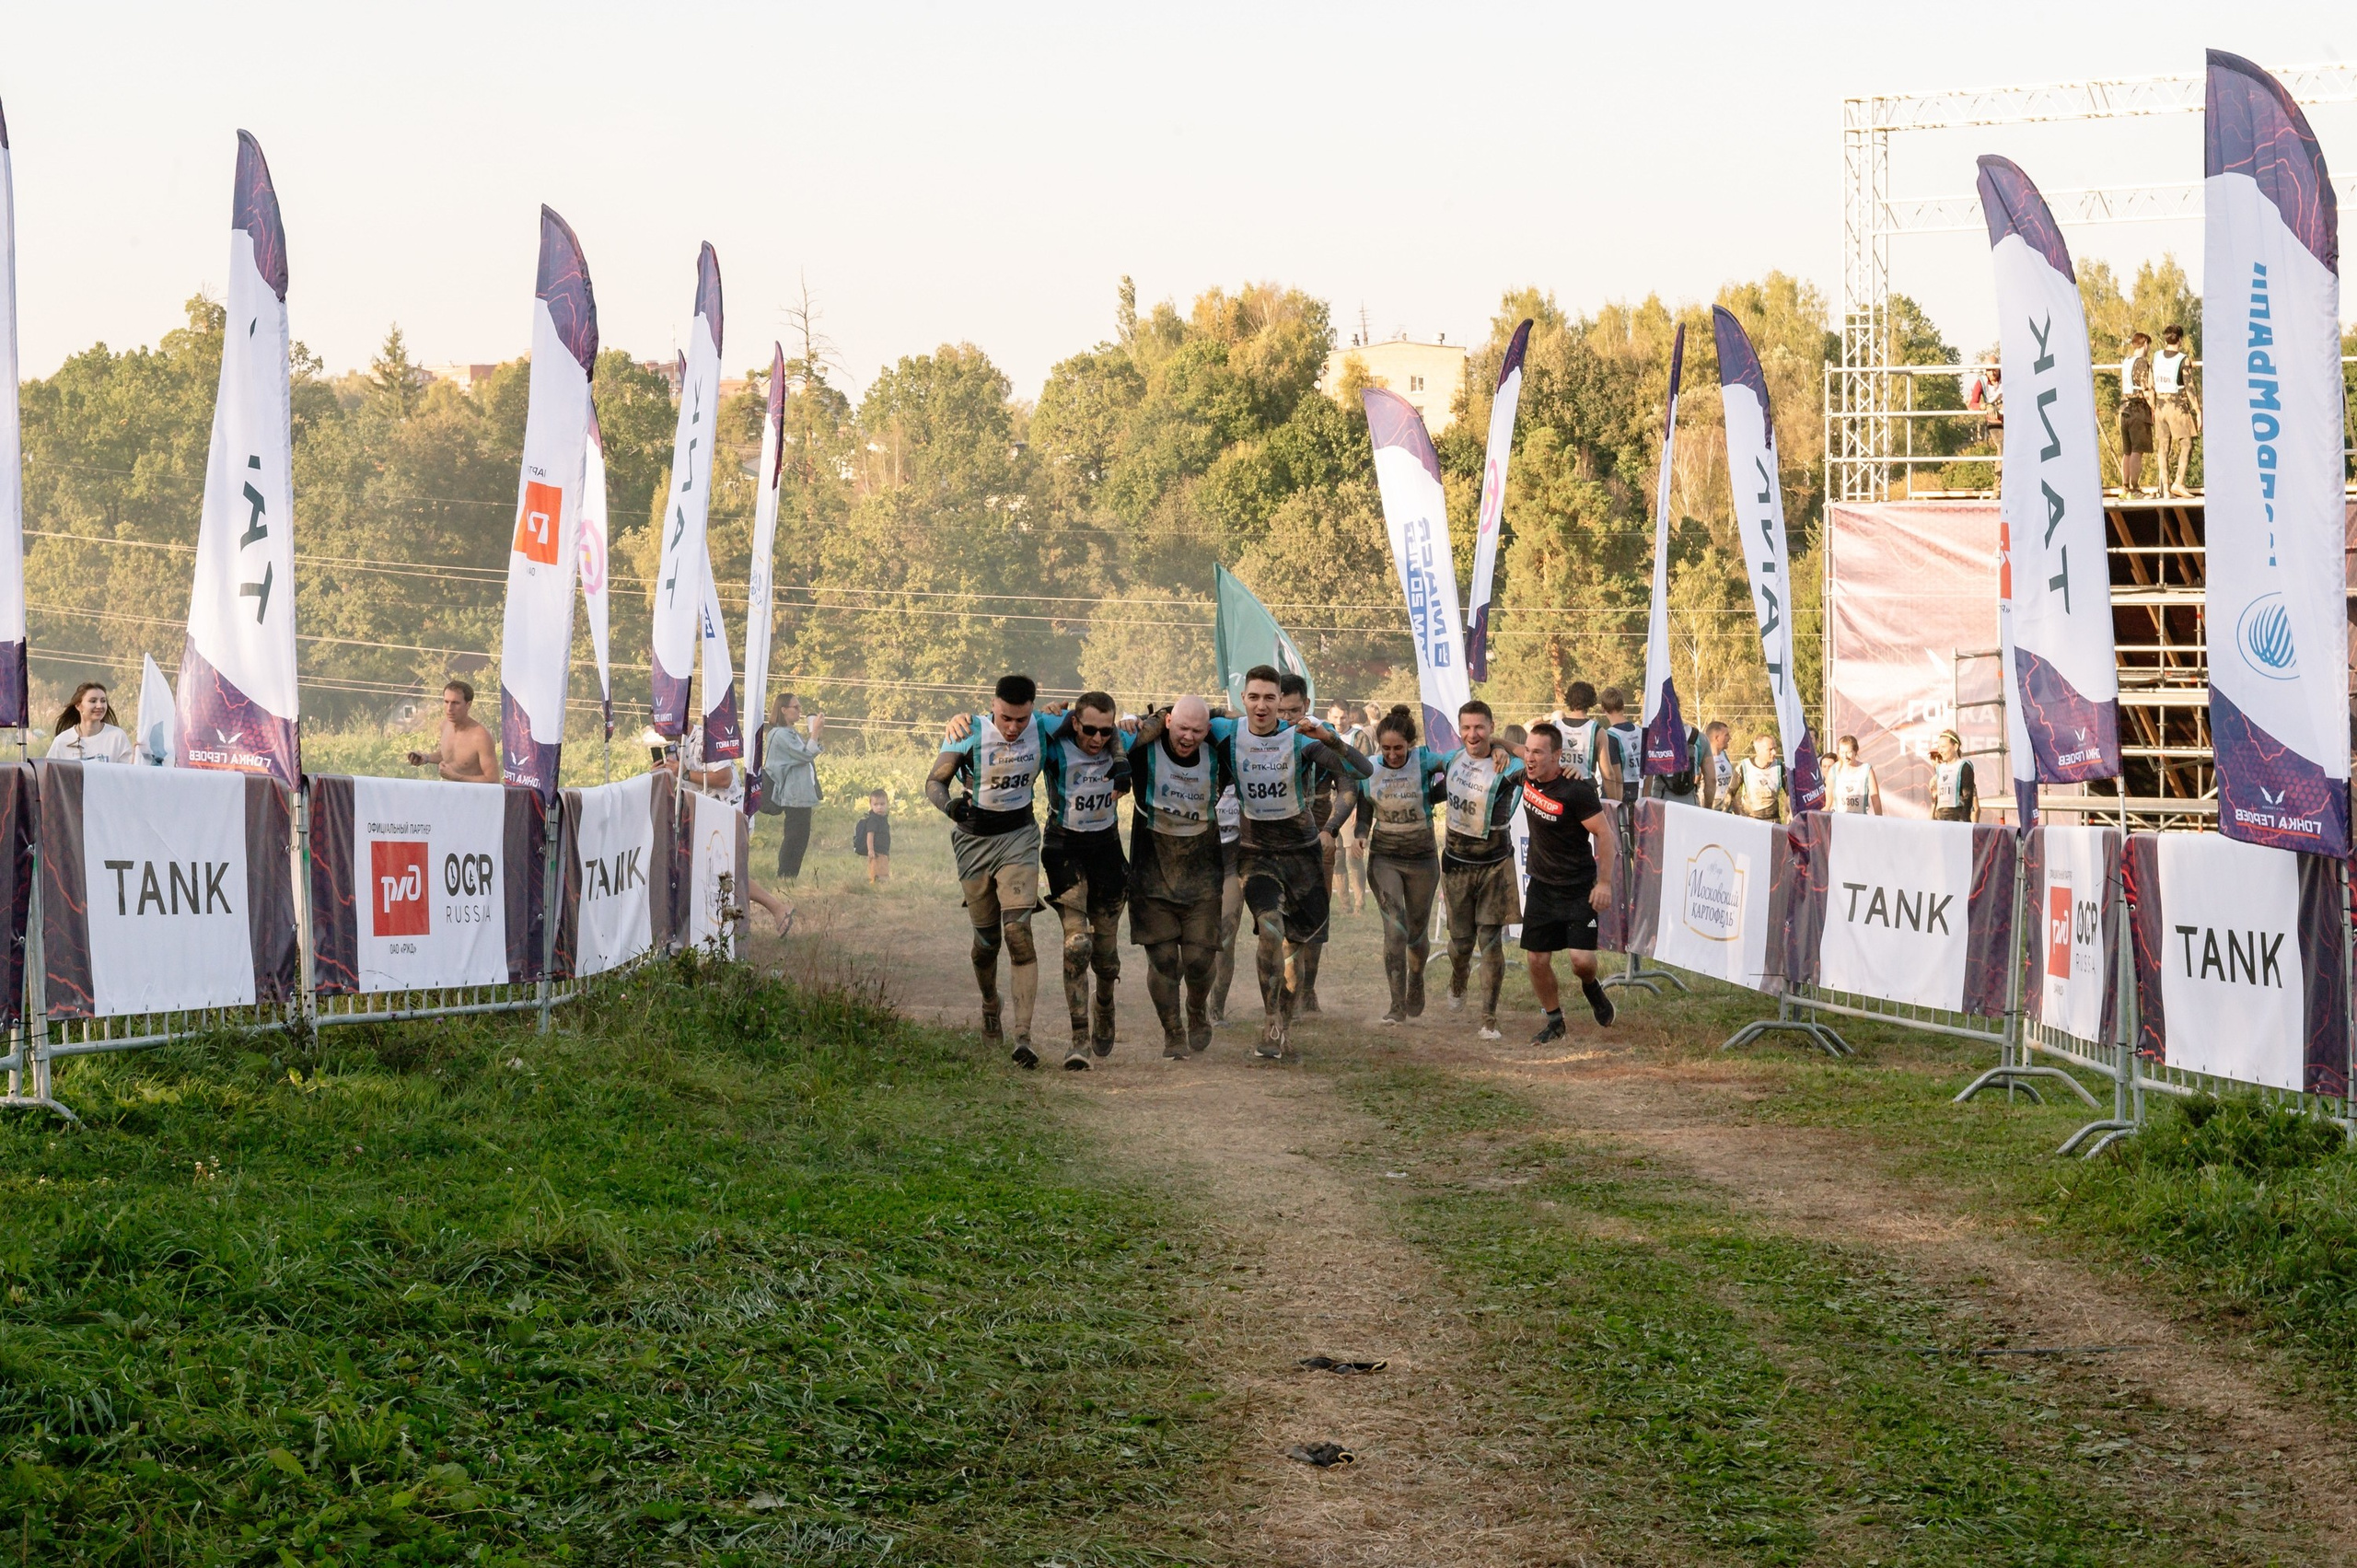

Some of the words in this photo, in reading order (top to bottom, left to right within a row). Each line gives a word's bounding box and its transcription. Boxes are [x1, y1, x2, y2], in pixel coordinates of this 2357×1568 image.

[999, 753, 1035, 764] РТК-ЦОД
[1252, 762, 1288, 771] РТК-ЦОД
[1561, 753, 1584, 764] 5315
[990, 772, 1030, 790] 5838
[1457, 776, 1484, 793] РТК-ЦОД
[1170, 790, 1205, 801] РТК-ЦОД
[1247, 782, 1288, 799] 5842
[1074, 793, 1113, 811] 6470
[1448, 791, 1477, 816] 5846
[367, 822, 409, 835] ОФИЦИАЛЬНЫЙ
[444, 853, 493, 897] OCR
[585, 845, 644, 902] TANK
[103, 860, 233, 916] TANK
[1688, 868, 1740, 908] Московский
[446, 905, 492, 923] RUSSIA
[1691, 901, 1734, 928] КАРТОФЕЛЬ
[1842, 881, 1955, 936] TANK
[2076, 900, 2098, 947] OCR
[389, 943, 400, 955] ОАО
[2175, 924, 2285, 989] TANK
